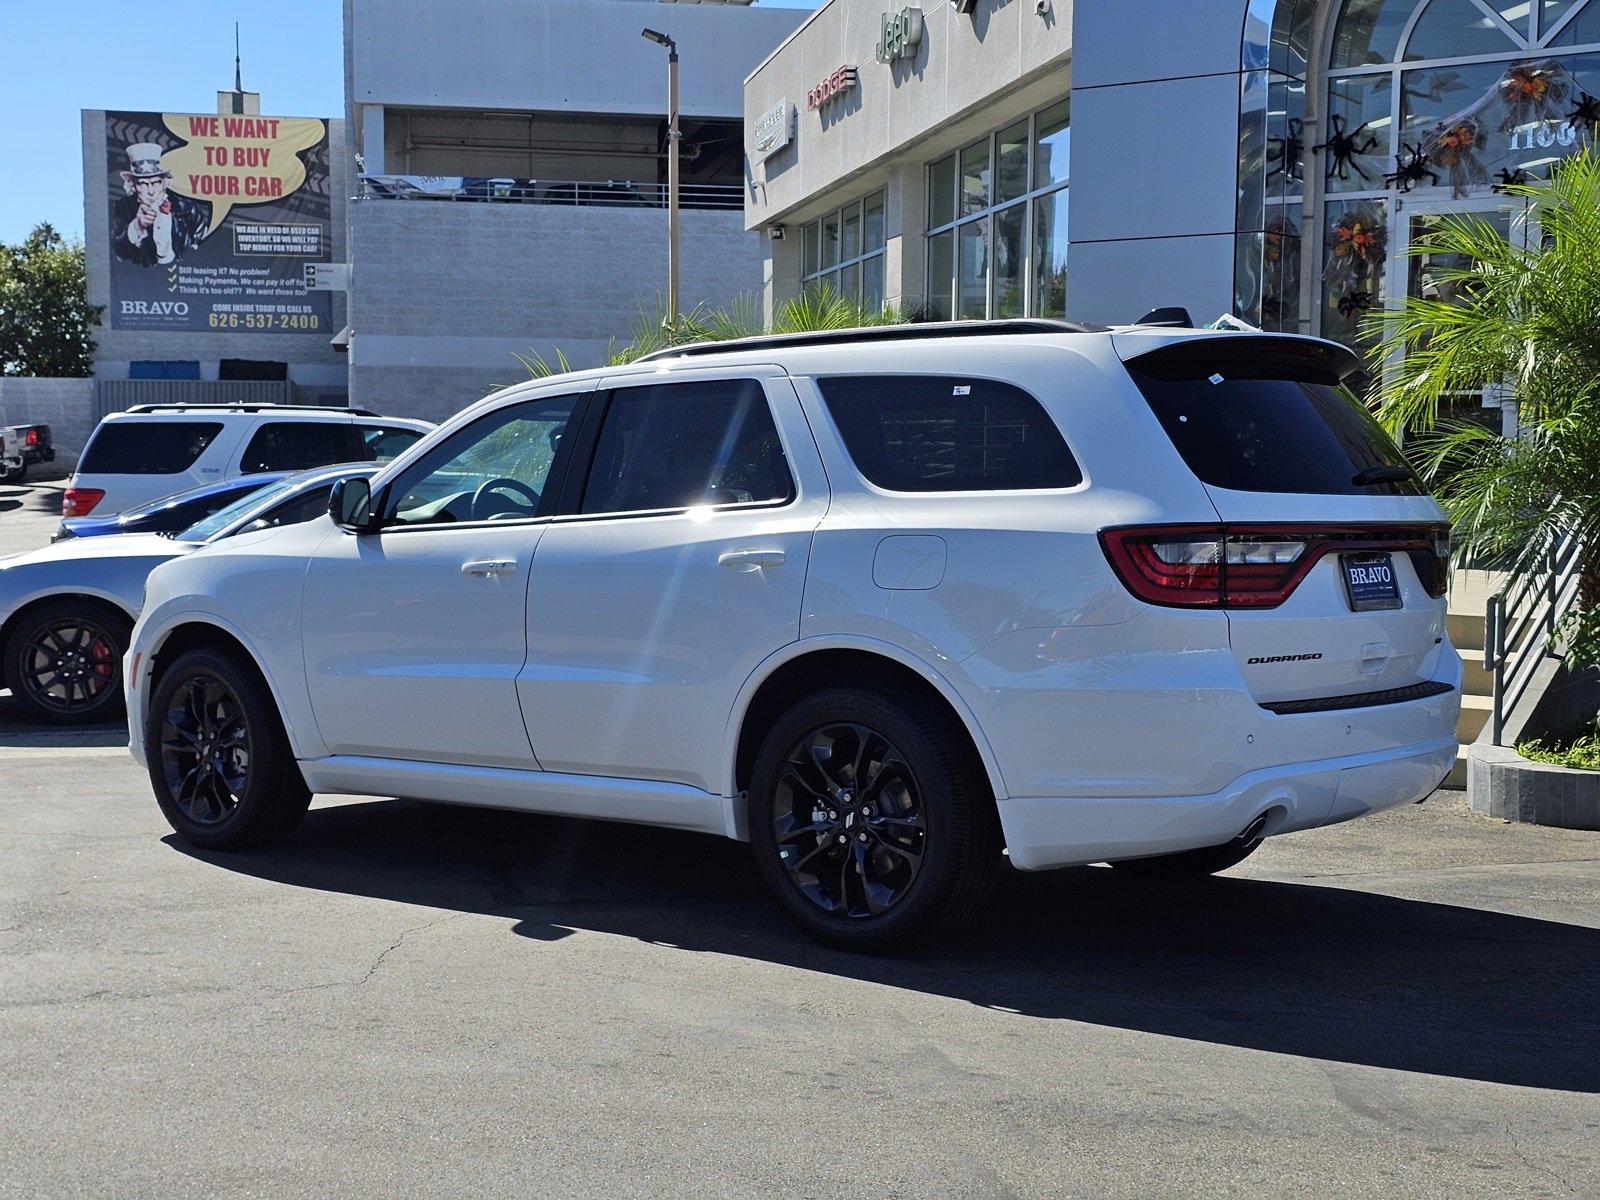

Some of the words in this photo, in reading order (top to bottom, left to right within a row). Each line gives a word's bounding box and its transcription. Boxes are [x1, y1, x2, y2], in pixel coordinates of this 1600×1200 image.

[875, 6, 923, 65] Jeep
[807, 64, 857, 112] DODGE
[189, 116, 219, 137] WE
[223, 117, 280, 139] WANT
[1508, 121, 1576, 150] 1100
[203, 146, 228, 167] TO
[233, 147, 271, 168] BUY
[188, 174, 240, 196] YOUR
[244, 176, 283, 197] CAR
[236, 225, 246, 233] WE
[260, 226, 266, 234] IN
[267, 226, 282, 235] NEED
[282, 226, 290, 235] OF
[290, 227, 306, 235] USED
[307, 227, 320, 235] CAR
[273, 235, 282, 243] SO
[282, 235, 292, 243] WE
[307, 236, 318, 244] PAY
[240, 243, 252, 252] TOP
[252, 244, 273, 252] MONEY
[273, 244, 286, 253] FOR
[286, 244, 302, 253] YOUR
[179, 266, 192, 274] Still
[193, 266, 217, 276] leasing
[219, 267, 228, 275] it?
[240, 268, 270, 277] problem!
[179, 276, 203, 286] Making
[240, 278, 253, 286] We
[179, 286, 198, 294] Think
[199, 286, 210, 294] it's
[223, 286, 242, 295] old??
[246, 287, 257, 295] We
[258, 287, 275, 296] want
[275, 288, 294, 296] those
[120, 300, 189, 316] BRAVO
[212, 303, 232, 312] COME
[233, 304, 255, 313] INSIDE
[255, 304, 277, 313] TODAY
[277, 305, 287, 313] OR
[287, 305, 302, 314] CALL
[303, 305, 313, 314] US
[208, 313, 320, 330] 626-537-2400
[1349, 566, 1391, 585] BRAVO
[1247, 652, 1323, 665] DURANGO
